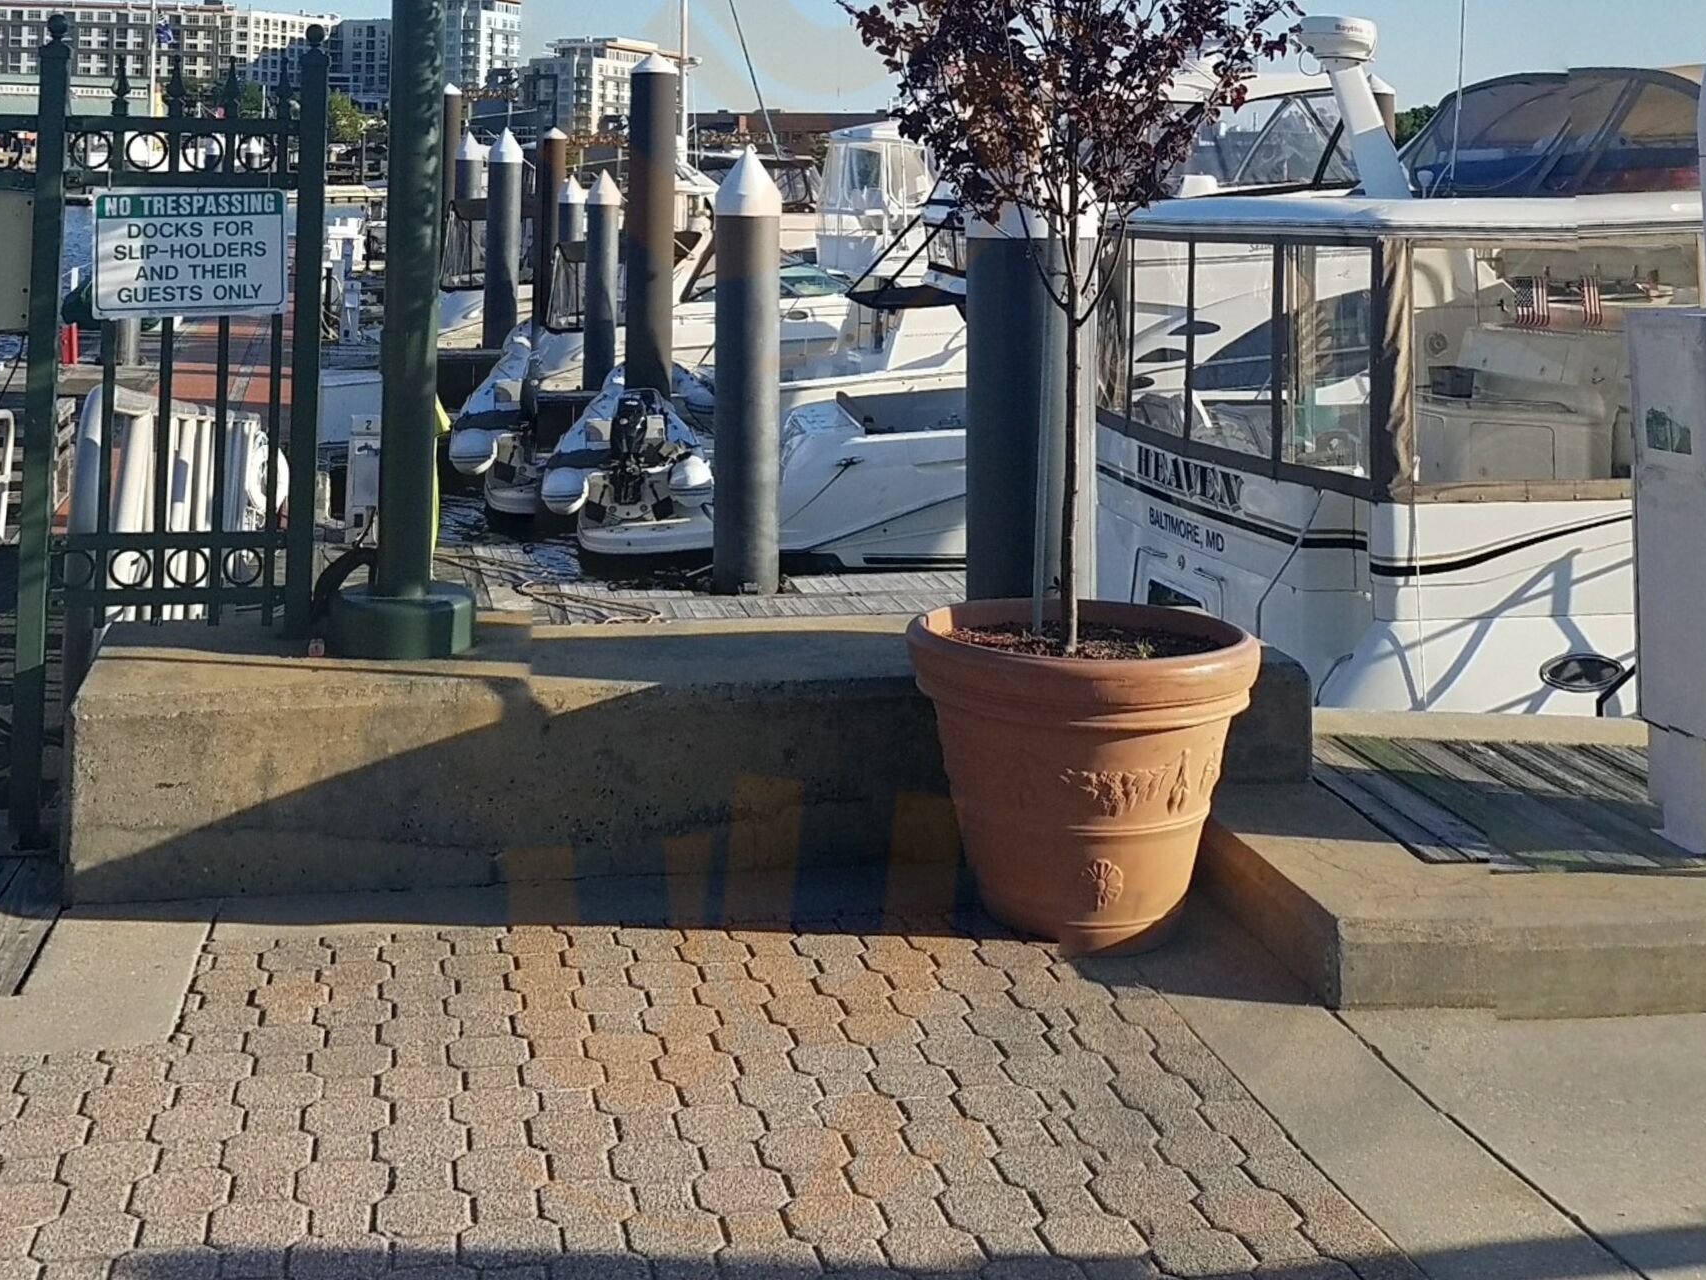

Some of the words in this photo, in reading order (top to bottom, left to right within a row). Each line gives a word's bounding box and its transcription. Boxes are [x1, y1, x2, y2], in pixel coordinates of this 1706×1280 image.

[104, 196, 131, 217] NO
[141, 193, 276, 215] TRESPASSING
[127, 221, 203, 239] DOCKS
[213, 220, 253, 236] FOR
[113, 241, 267, 261] SLIP-HOLDERS
[135, 265, 179, 281] AND
[187, 263, 247, 280] THEIR
[117, 286, 203, 304] GUESTS
[213, 283, 263, 301] ONLY
[1137, 445, 1244, 513] HEAVEN
[1148, 506, 1204, 550] BALTIMORE,
[1206, 529, 1225, 552] MD
